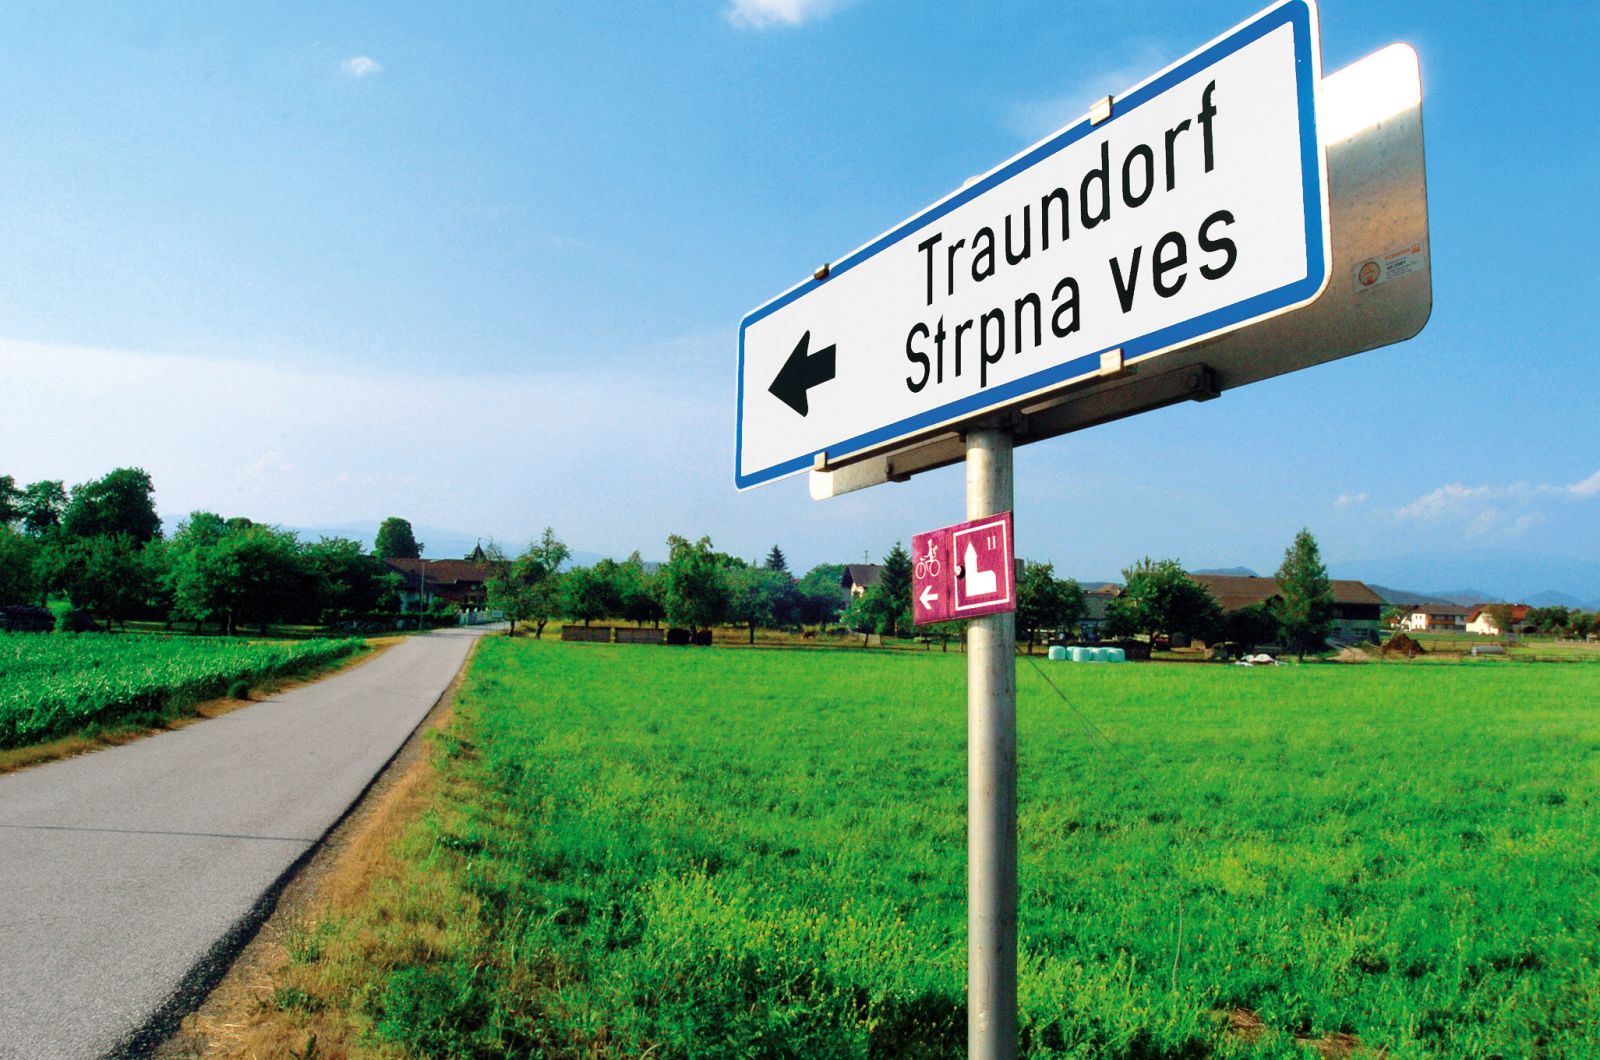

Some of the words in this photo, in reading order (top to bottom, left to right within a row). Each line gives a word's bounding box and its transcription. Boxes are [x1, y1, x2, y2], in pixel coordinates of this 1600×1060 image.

[918, 79, 1217, 306] Traundorf
[906, 277, 1080, 393] Strpna
[1109, 210, 1238, 314] ves
